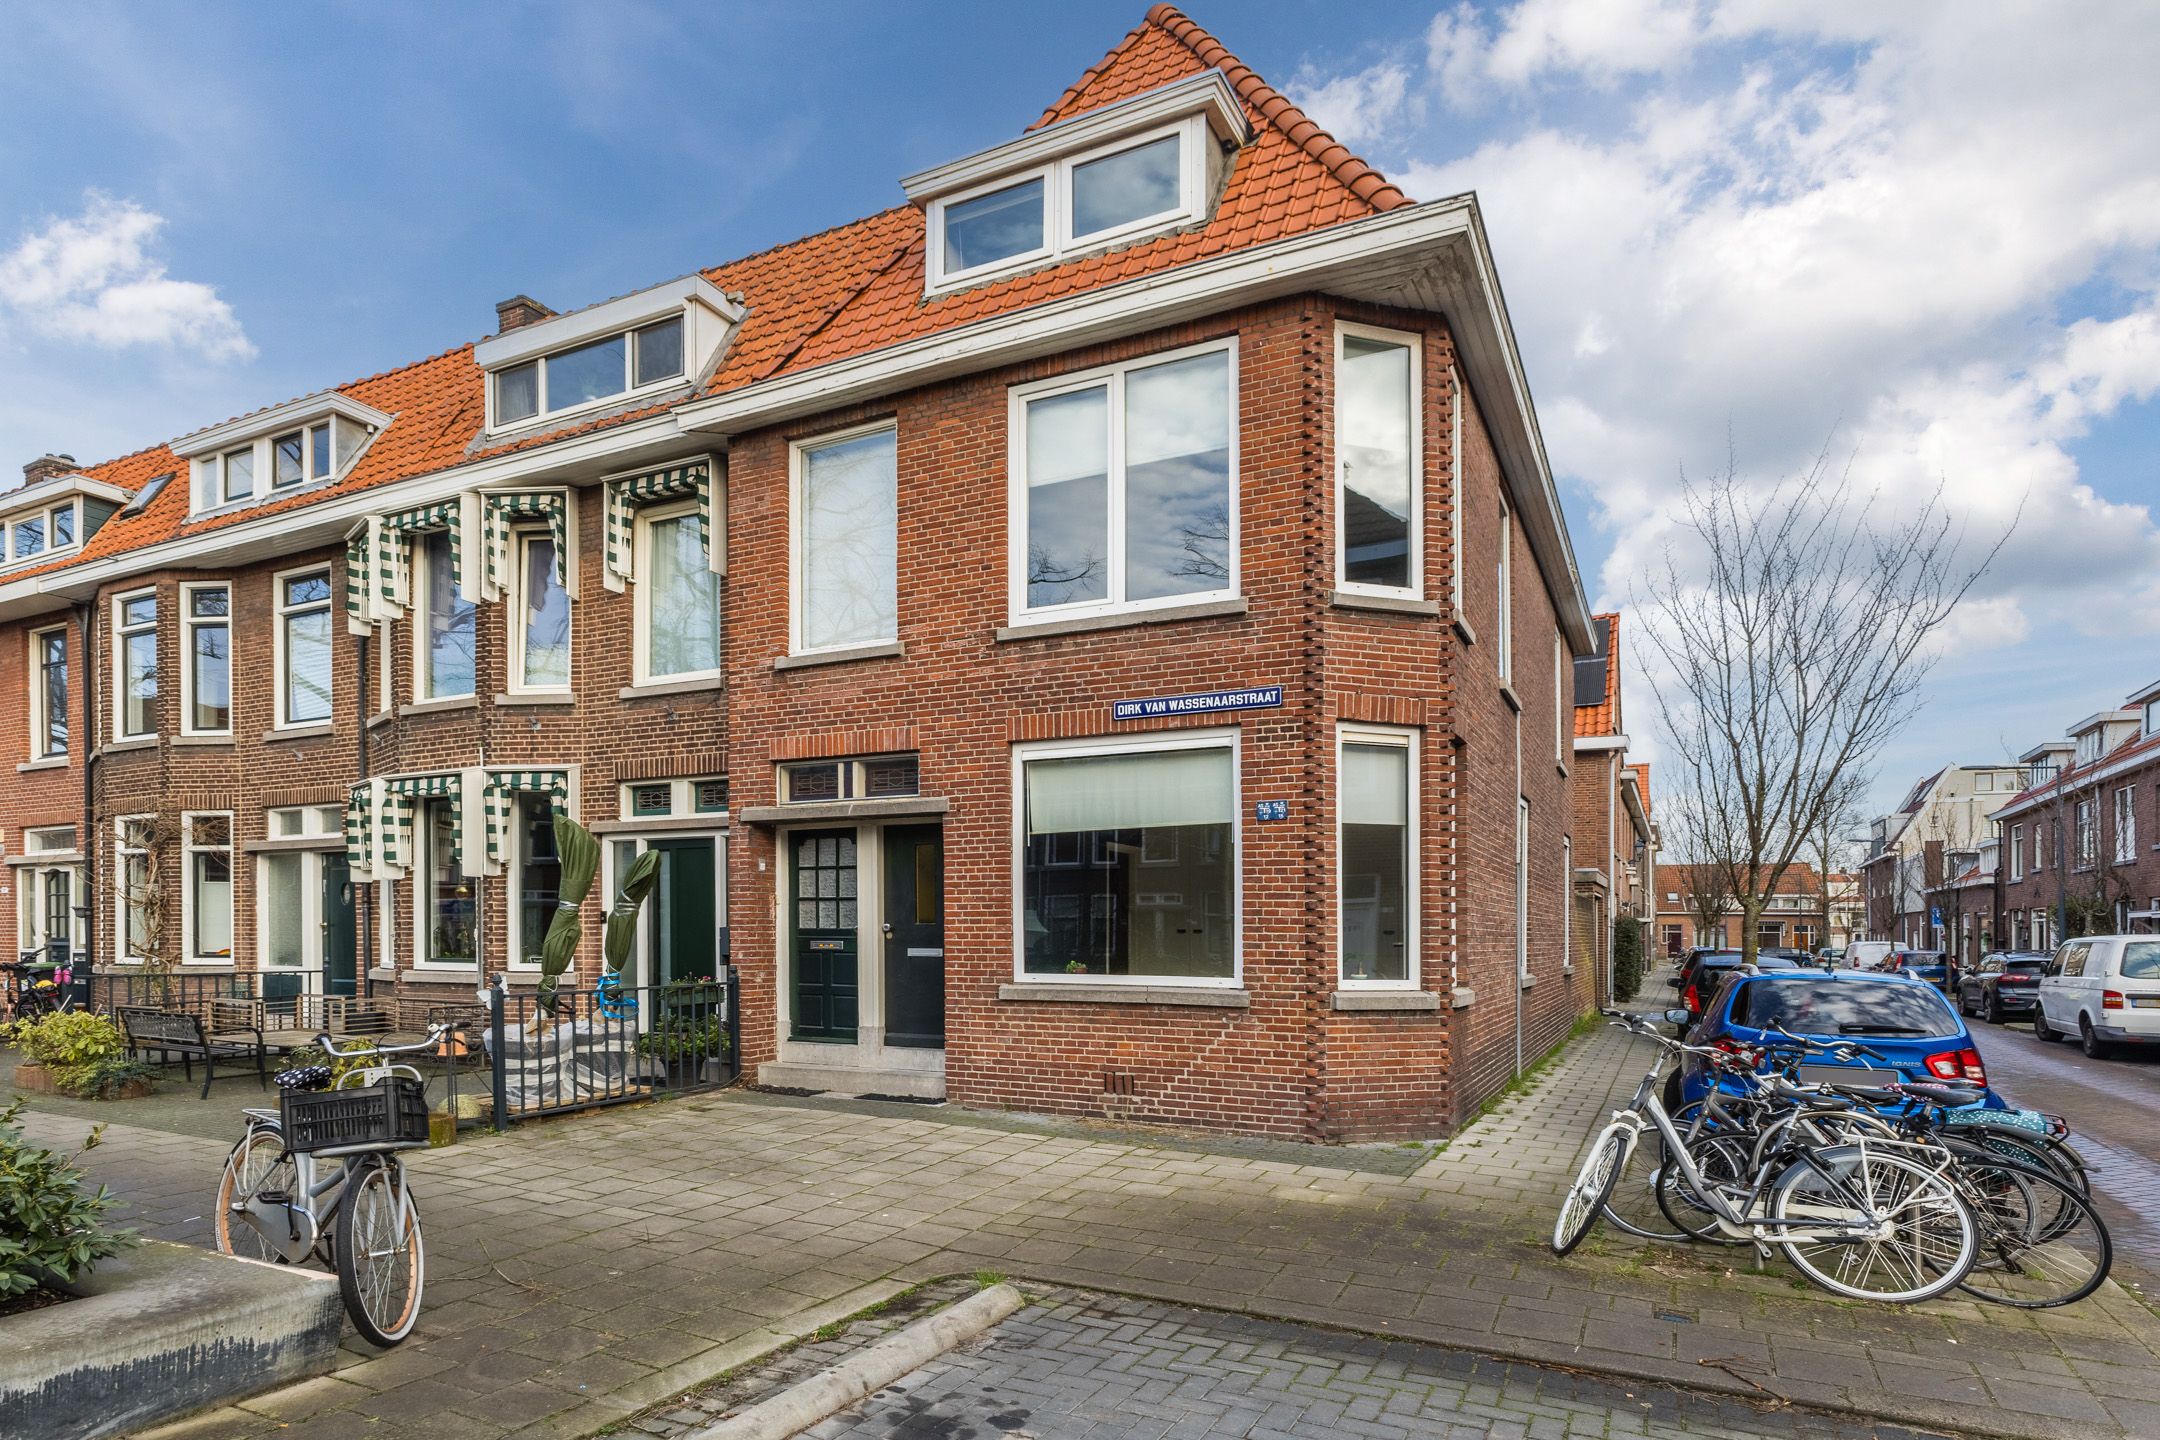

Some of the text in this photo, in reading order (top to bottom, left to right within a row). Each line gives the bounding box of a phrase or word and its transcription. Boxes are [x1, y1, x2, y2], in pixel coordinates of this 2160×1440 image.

[1117, 690, 1278, 716] DIRK VAN WASSENAARSTRAAT
[1891, 1060, 1921, 1068] IGNIS
